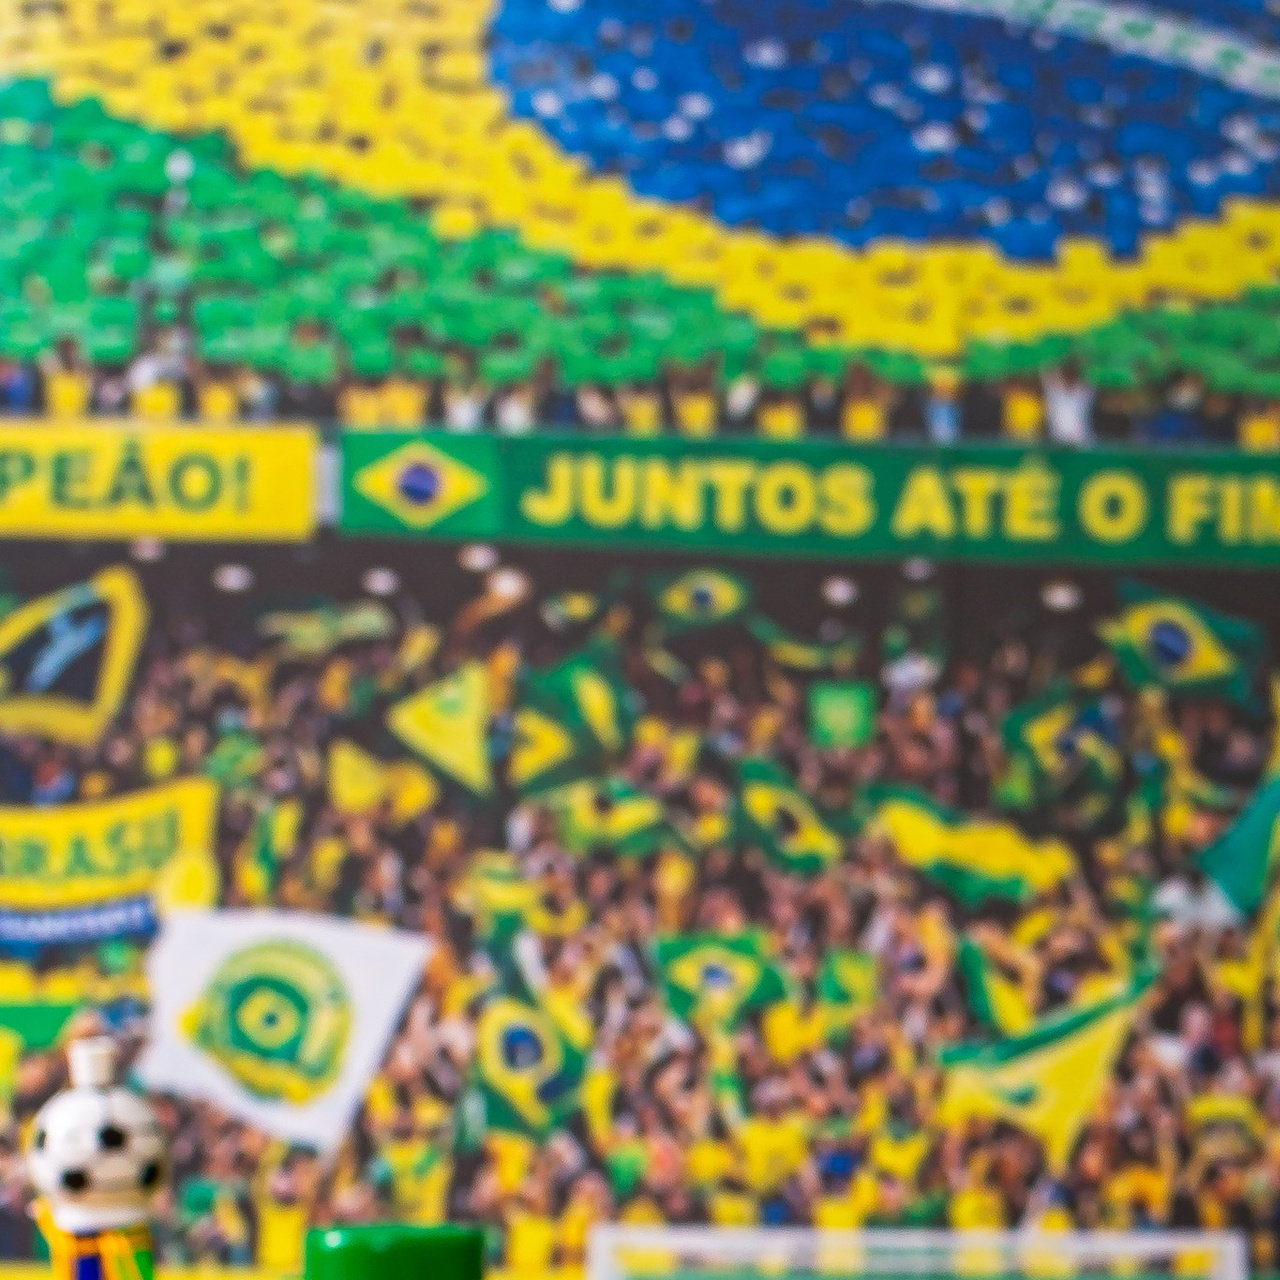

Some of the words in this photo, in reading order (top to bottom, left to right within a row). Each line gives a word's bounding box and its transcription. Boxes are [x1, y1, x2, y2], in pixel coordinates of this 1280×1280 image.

[520, 450, 876, 537] JUNTOS
[890, 456, 1062, 542] ATÉ
[1078, 467, 1149, 544] O
